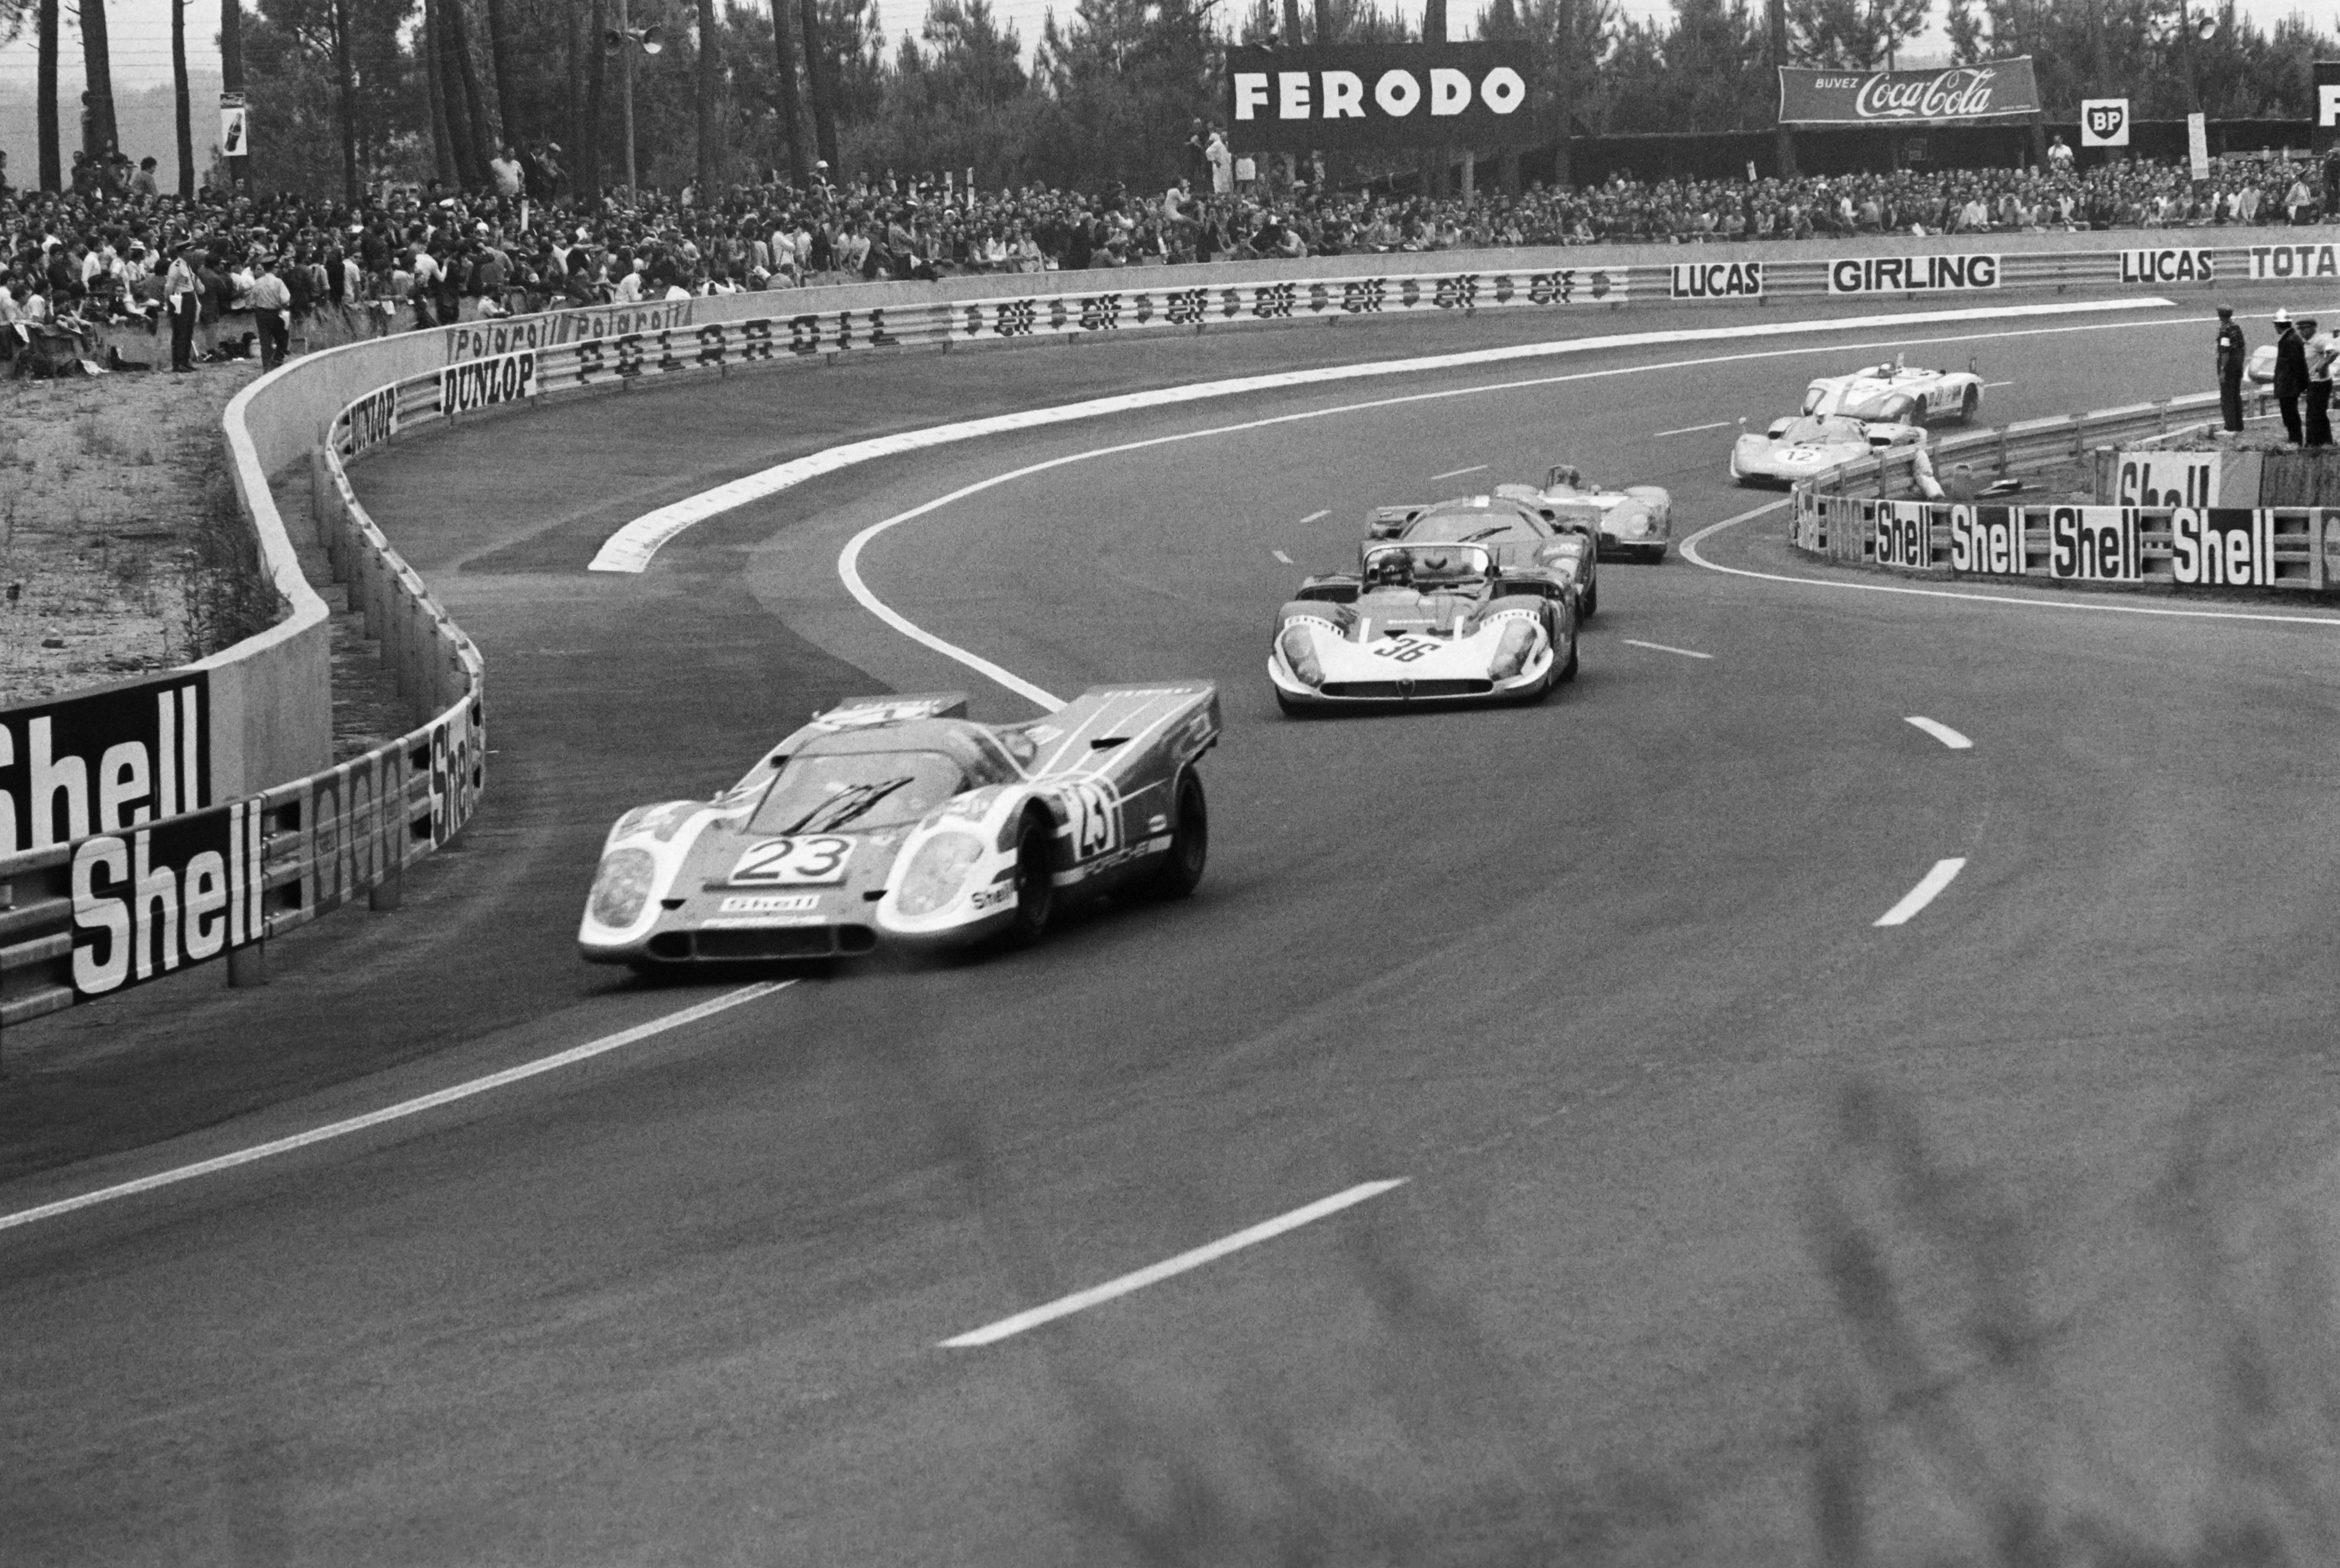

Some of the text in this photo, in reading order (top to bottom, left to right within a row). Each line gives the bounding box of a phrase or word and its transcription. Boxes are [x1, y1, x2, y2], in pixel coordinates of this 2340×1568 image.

[1233, 67, 1526, 120] FERODO
[1815, 68, 1997, 117] BUVEZ Coca-Cola
[2091, 111, 2121, 130] BP
[1673, 263, 1760, 297] LUCAS
[1834, 255, 1996, 292] GIRLING
[2122, 250, 2213, 283] LUCAS
[2251, 245, 2338, 278] TOTA
[443, 353, 533, 415] DUNLOP
[1878, 501, 1931, 567] Shell
[1952, 504, 2025, 574] Shell
[2054, 507, 2141, 578] Shell
[2172, 507, 2274, 585] Shell
[1373, 638, 1441, 662] 36
[0, 685, 198, 861] hell
[733, 838, 849, 880] 23
[72, 799, 263, 994] Shell
